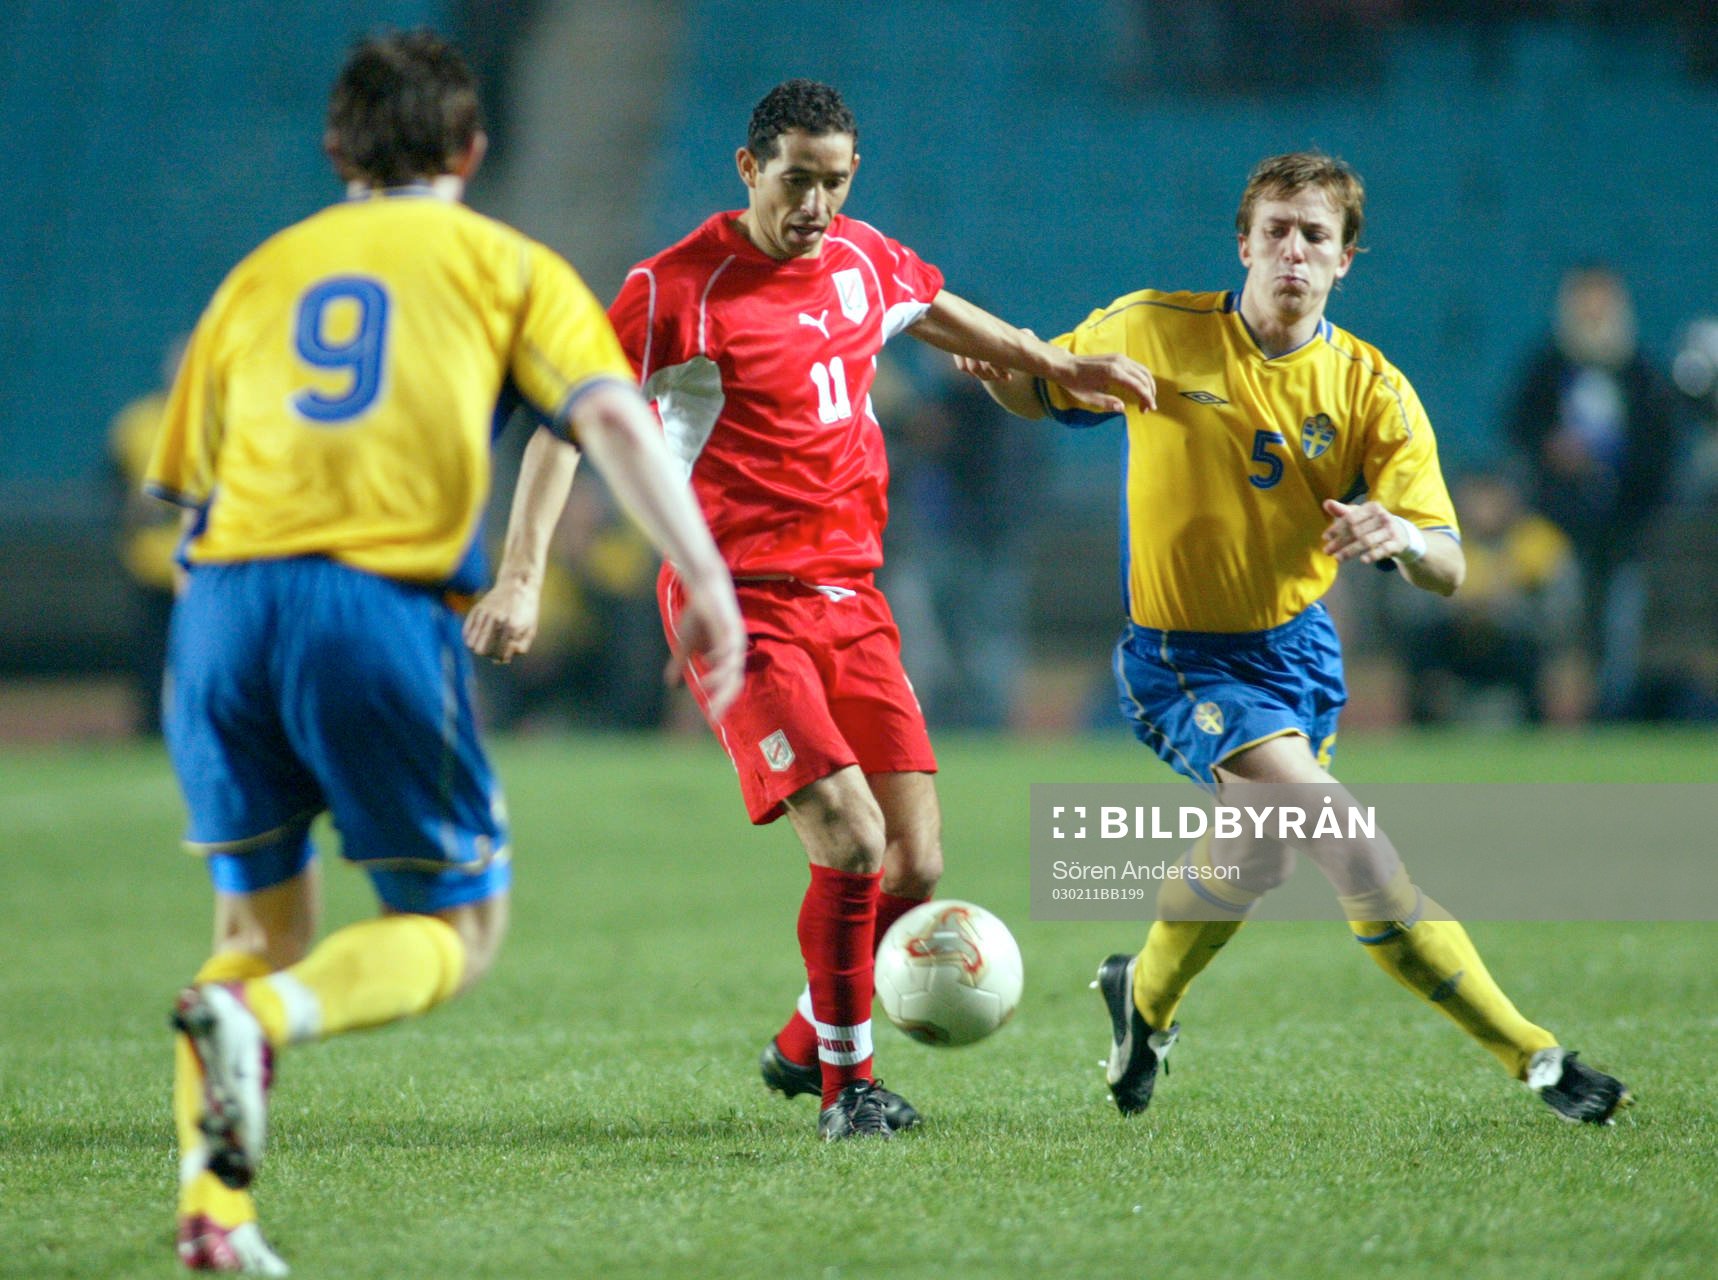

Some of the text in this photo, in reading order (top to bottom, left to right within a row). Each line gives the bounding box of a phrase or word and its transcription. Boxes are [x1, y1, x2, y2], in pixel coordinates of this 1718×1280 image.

[294, 275, 389, 422] 9
[810, 356, 851, 424] 11
[1248, 429, 1284, 489] 5
